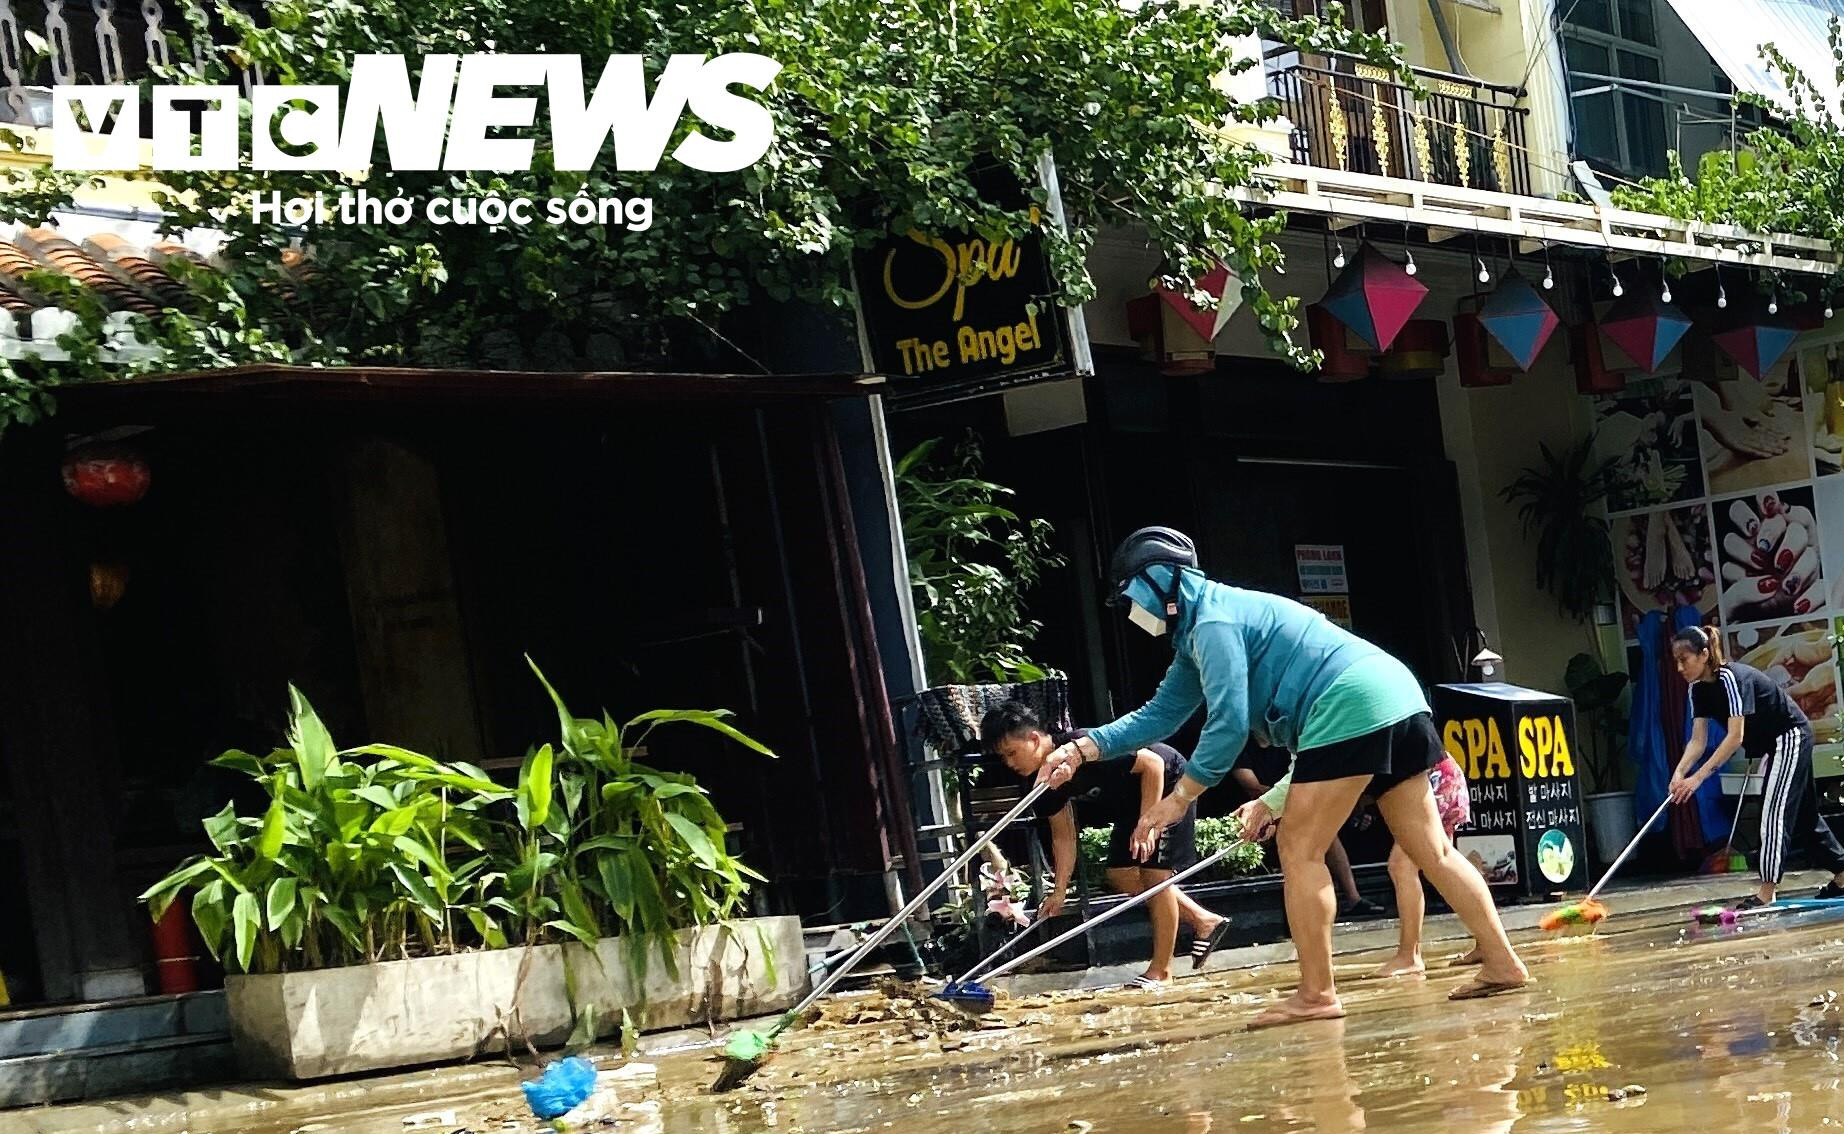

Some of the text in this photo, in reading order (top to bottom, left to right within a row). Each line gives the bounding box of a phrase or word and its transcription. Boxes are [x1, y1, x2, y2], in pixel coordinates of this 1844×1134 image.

[883, 227, 1021, 321] Spa
[896, 313, 1041, 375] The Angel
[1443, 716, 1511, 779] SPA
[1518, 715, 1574, 779] SPA
[1471, 783, 1508, 804] 마사지
[1527, 780, 1572, 803] 발 마사지
[1481, 809, 1516, 829] 마사지
[1525, 805, 1580, 829] 전신 마사지
